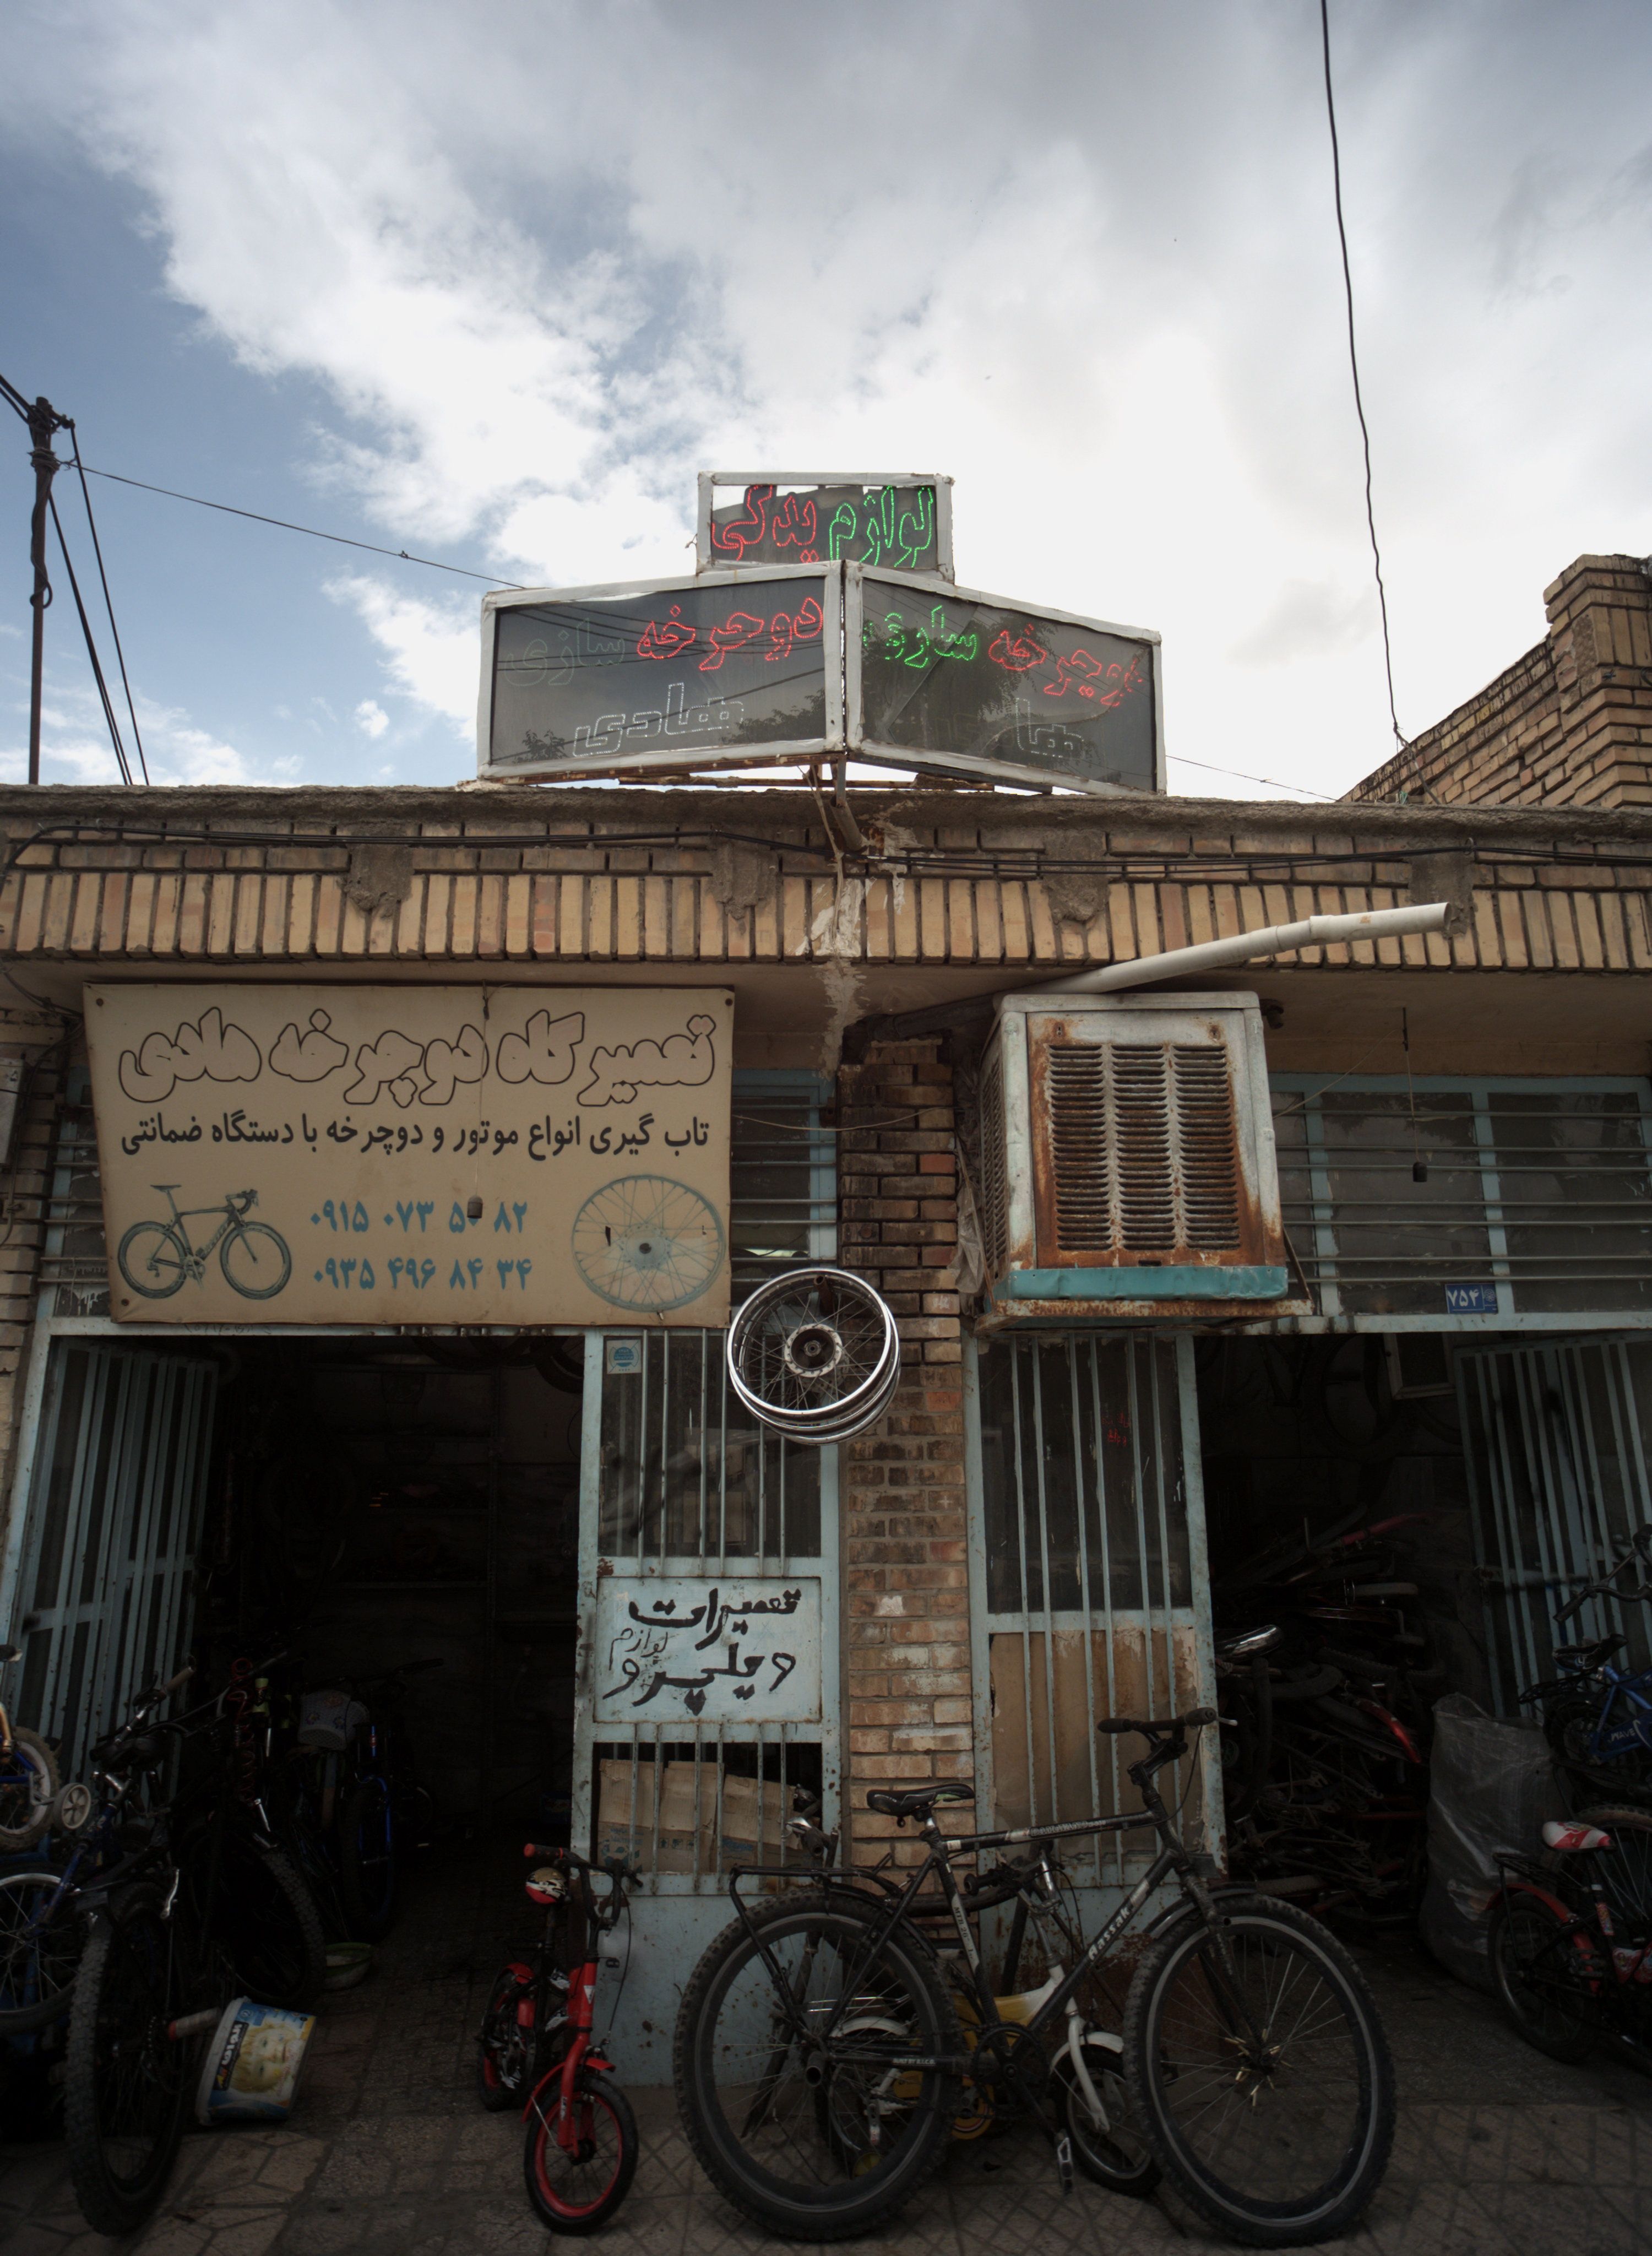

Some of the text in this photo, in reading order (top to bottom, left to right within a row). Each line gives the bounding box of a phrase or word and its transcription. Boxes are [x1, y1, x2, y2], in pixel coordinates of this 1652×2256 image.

[829, 485, 933, 568] لوازم
[269, 1008, 488, 1108] دوچرخه
[121, 1109, 709, 1161] تاب گیری انواع موتور و دوچرخه با دستگاه ضمانتی
[311, 1200, 369, 1233] ۰۹۱۵
[384, 1200, 434, 1233] ۰۷۳
[493, 1201, 528, 1234] ۸۲
[313, 1257, 532, 1291] ۰۹۳۵ ۴۹۶ ۸۴ ۳۴
[1446, 1289, 1480, 1307] ۷۵۴
[628, 1587, 802, 1651] تعمیرات
[608, 1628, 669, 1671] لوازم
[1610, 1728, 1636, 1742] WAVE
